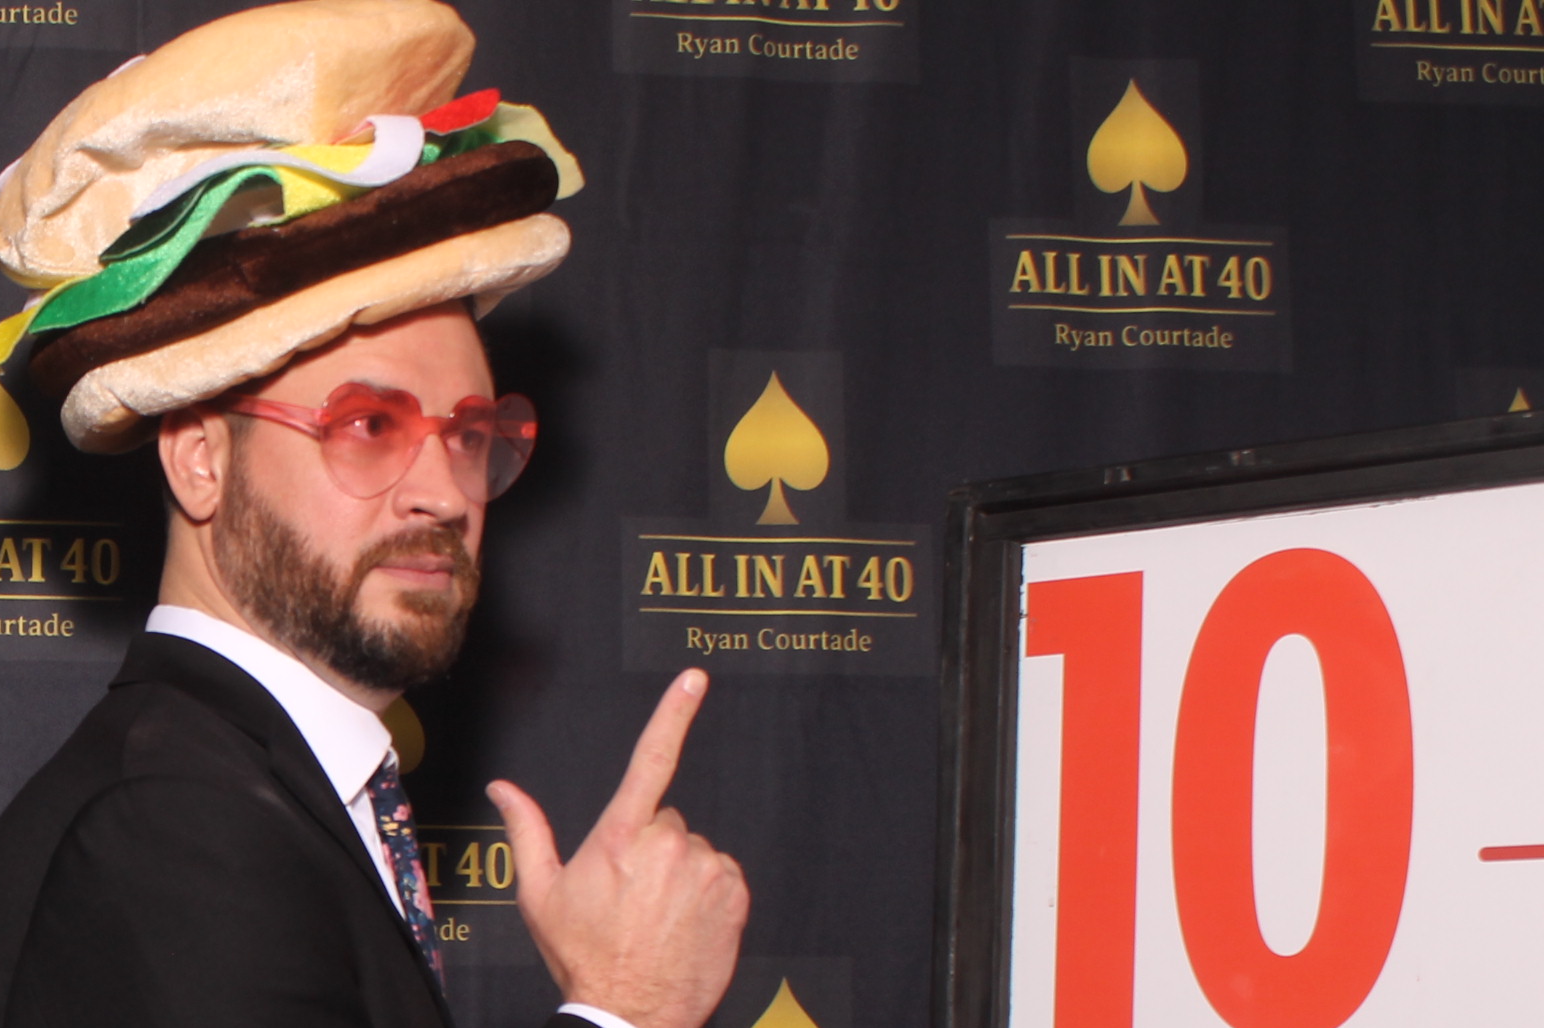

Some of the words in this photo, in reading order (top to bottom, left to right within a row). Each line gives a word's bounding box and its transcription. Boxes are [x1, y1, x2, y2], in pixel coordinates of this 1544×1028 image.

[1371, 0, 1452, 34] ALL
[1459, 0, 1505, 36] IN
[1513, 0, 1544, 37] A
[676, 31, 742, 60] Ryan
[748, 33, 861, 61] Courtade
[1416, 59, 1476, 87] Ryan
[1481, 62, 1544, 85] Court
[1010, 249, 1090, 296] ALL
[1098, 254, 1147, 297] IN
[1157, 253, 1210, 297] AT
[1218, 255, 1272, 301] 40
[1054, 322, 1115, 352] Ryan
[1121, 324, 1234, 349] Courtade
[59, 537, 122, 586] 40
[641, 550, 725, 598] ALL
[734, 554, 785, 598] IN
[794, 554, 850, 599] AT
[858, 556, 914, 603] 40
[686, 626, 750, 656] Ryan
[757, 627, 873, 652] Courtade
[420, 842, 448, 887] T
[455, 841, 516, 890] 40
